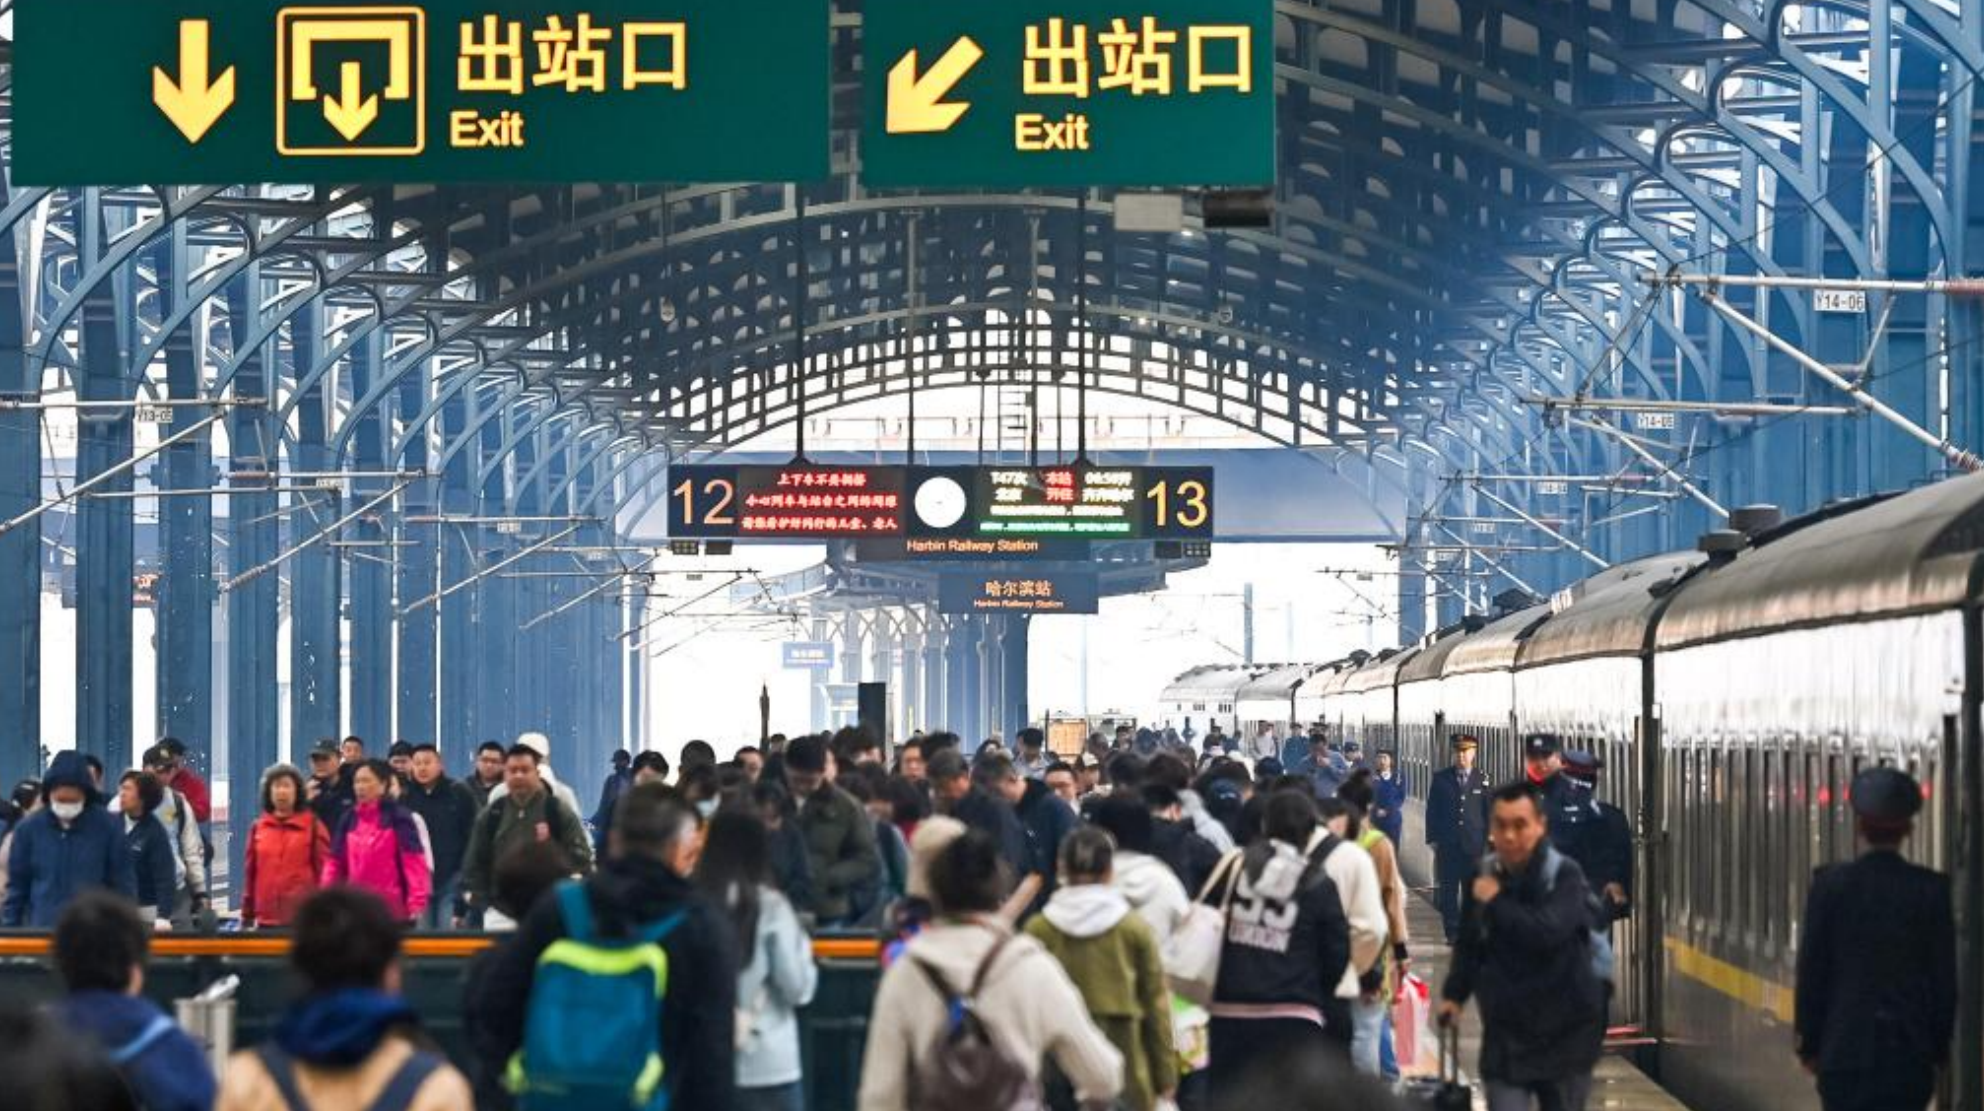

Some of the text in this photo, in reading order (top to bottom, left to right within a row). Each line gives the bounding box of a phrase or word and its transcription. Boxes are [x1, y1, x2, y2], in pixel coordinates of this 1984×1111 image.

[457, 13, 687, 95] 出站口
[1023, 16, 1252, 98] 出站口
[450, 110, 524, 147] Exit
[1015, 113, 1089, 150] Exit
[673, 479, 734, 525] 12
[1147, 480, 1208, 527] 13
[906, 539, 1039, 553] Harbin Railway Station
[984, 580, 1052, 597] 哈尔滨站
